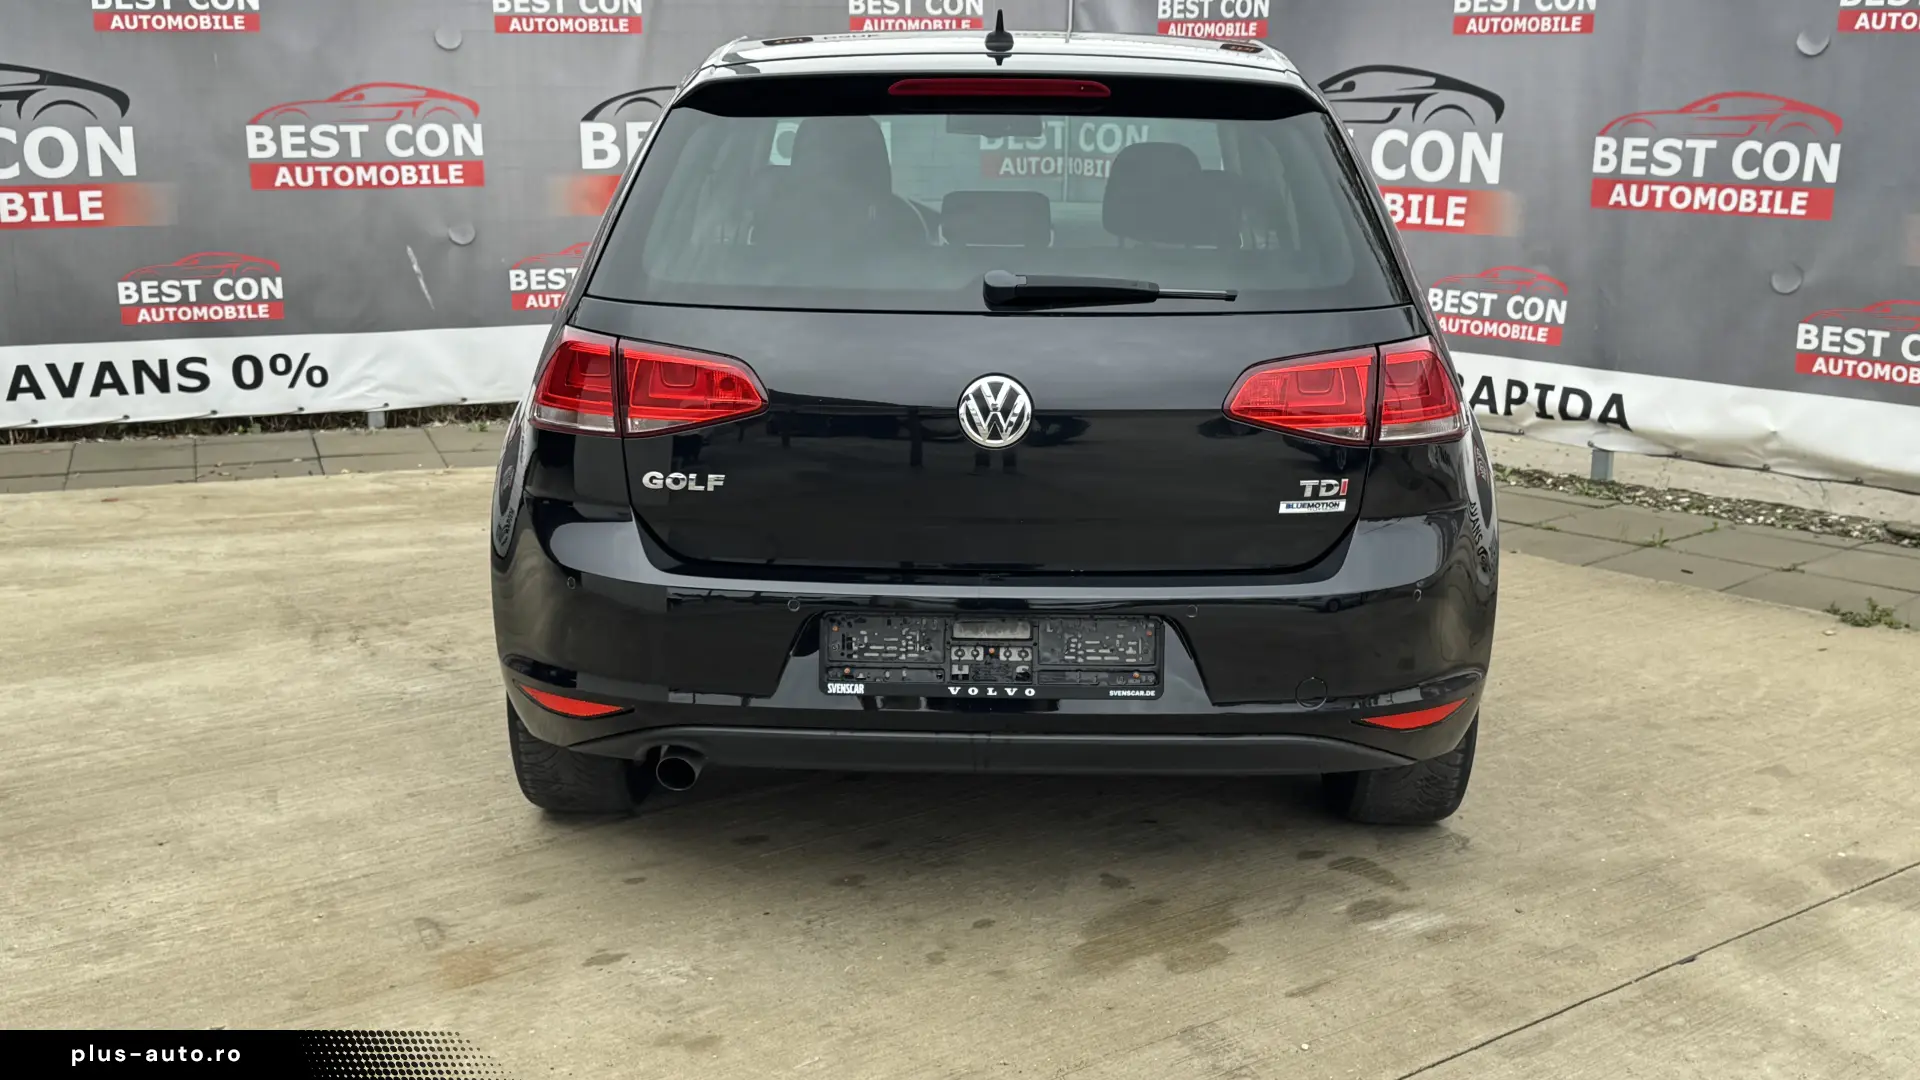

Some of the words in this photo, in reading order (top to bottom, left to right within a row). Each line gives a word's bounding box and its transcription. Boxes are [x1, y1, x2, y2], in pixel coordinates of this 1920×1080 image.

[110, 15, 246, 30] AUTOMOBILE
[509, 18, 629, 33] AUTOMOBILE
[862, 18, 972, 31] AUTOMOBILE
[1167, 22, 1257, 37] AUTOMOBILE
[1465, 16, 1582, 33] AUTOMOBILE
[1854, 12, 1920, 30] AUTO
[245, 125, 369, 159] BEST
[385, 123, 484, 158] CON
[1371, 129, 1503, 184] CON
[1592, 136, 1717, 178] BEST
[1731, 141, 1841, 183] CON
[274, 164, 464, 188] AUTOMOBILE
[1608, 185, 1809, 216] AUTOMOBILE
[117, 279, 201, 305] BEST
[213, 277, 284, 301] CON
[137, 304, 270, 323] AUTOMOBILE
[1428, 288, 1498, 316] BEST
[1506, 295, 1567, 325] CON
[1439, 317, 1549, 343] AUTOMOBILE
[1796, 323, 1890, 357] BEST
[7, 356, 211, 401] AVANS
[231, 352, 330, 391] 0%
[1457, 373, 1633, 432] APIDA
[642, 471, 726, 491] GOLF
[1300, 478, 1349, 497] TDI
[827, 683, 865, 694] SVENSCAR
[948, 686, 1036, 697] VOLVO
